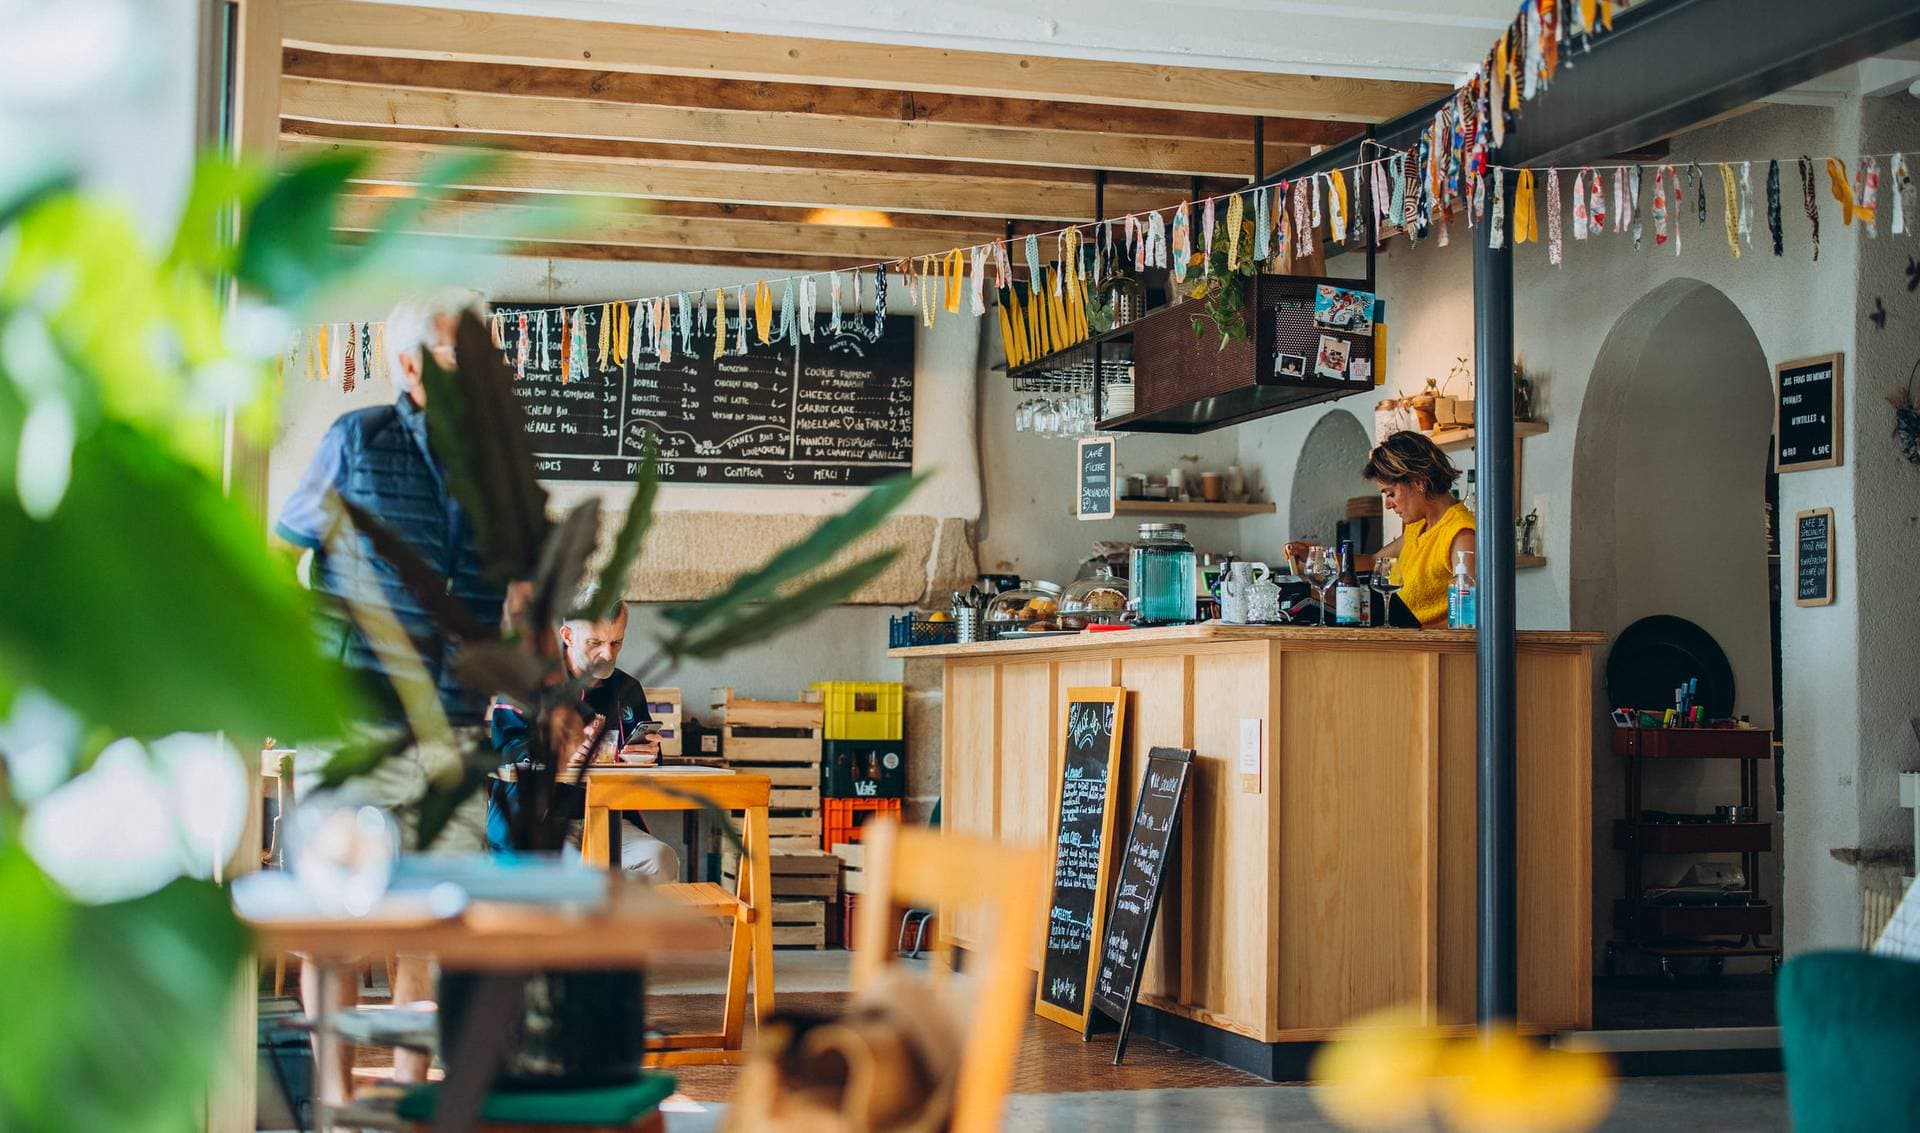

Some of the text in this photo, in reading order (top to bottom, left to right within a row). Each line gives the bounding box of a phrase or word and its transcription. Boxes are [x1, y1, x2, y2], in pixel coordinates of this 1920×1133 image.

[804, 367, 835, 378] COOKIE
[799, 389, 832, 400] CHEESE
[797, 403, 830, 413] CARROT
[831, 405, 855, 414] CAKE
[795, 434, 834, 447] FINANCIER
[592, 462, 601, 472] &
[813, 469, 838, 480] MERCI
[1082, 486, 1110, 497] SALVADOR
[854, 781, 877, 796] Vals
